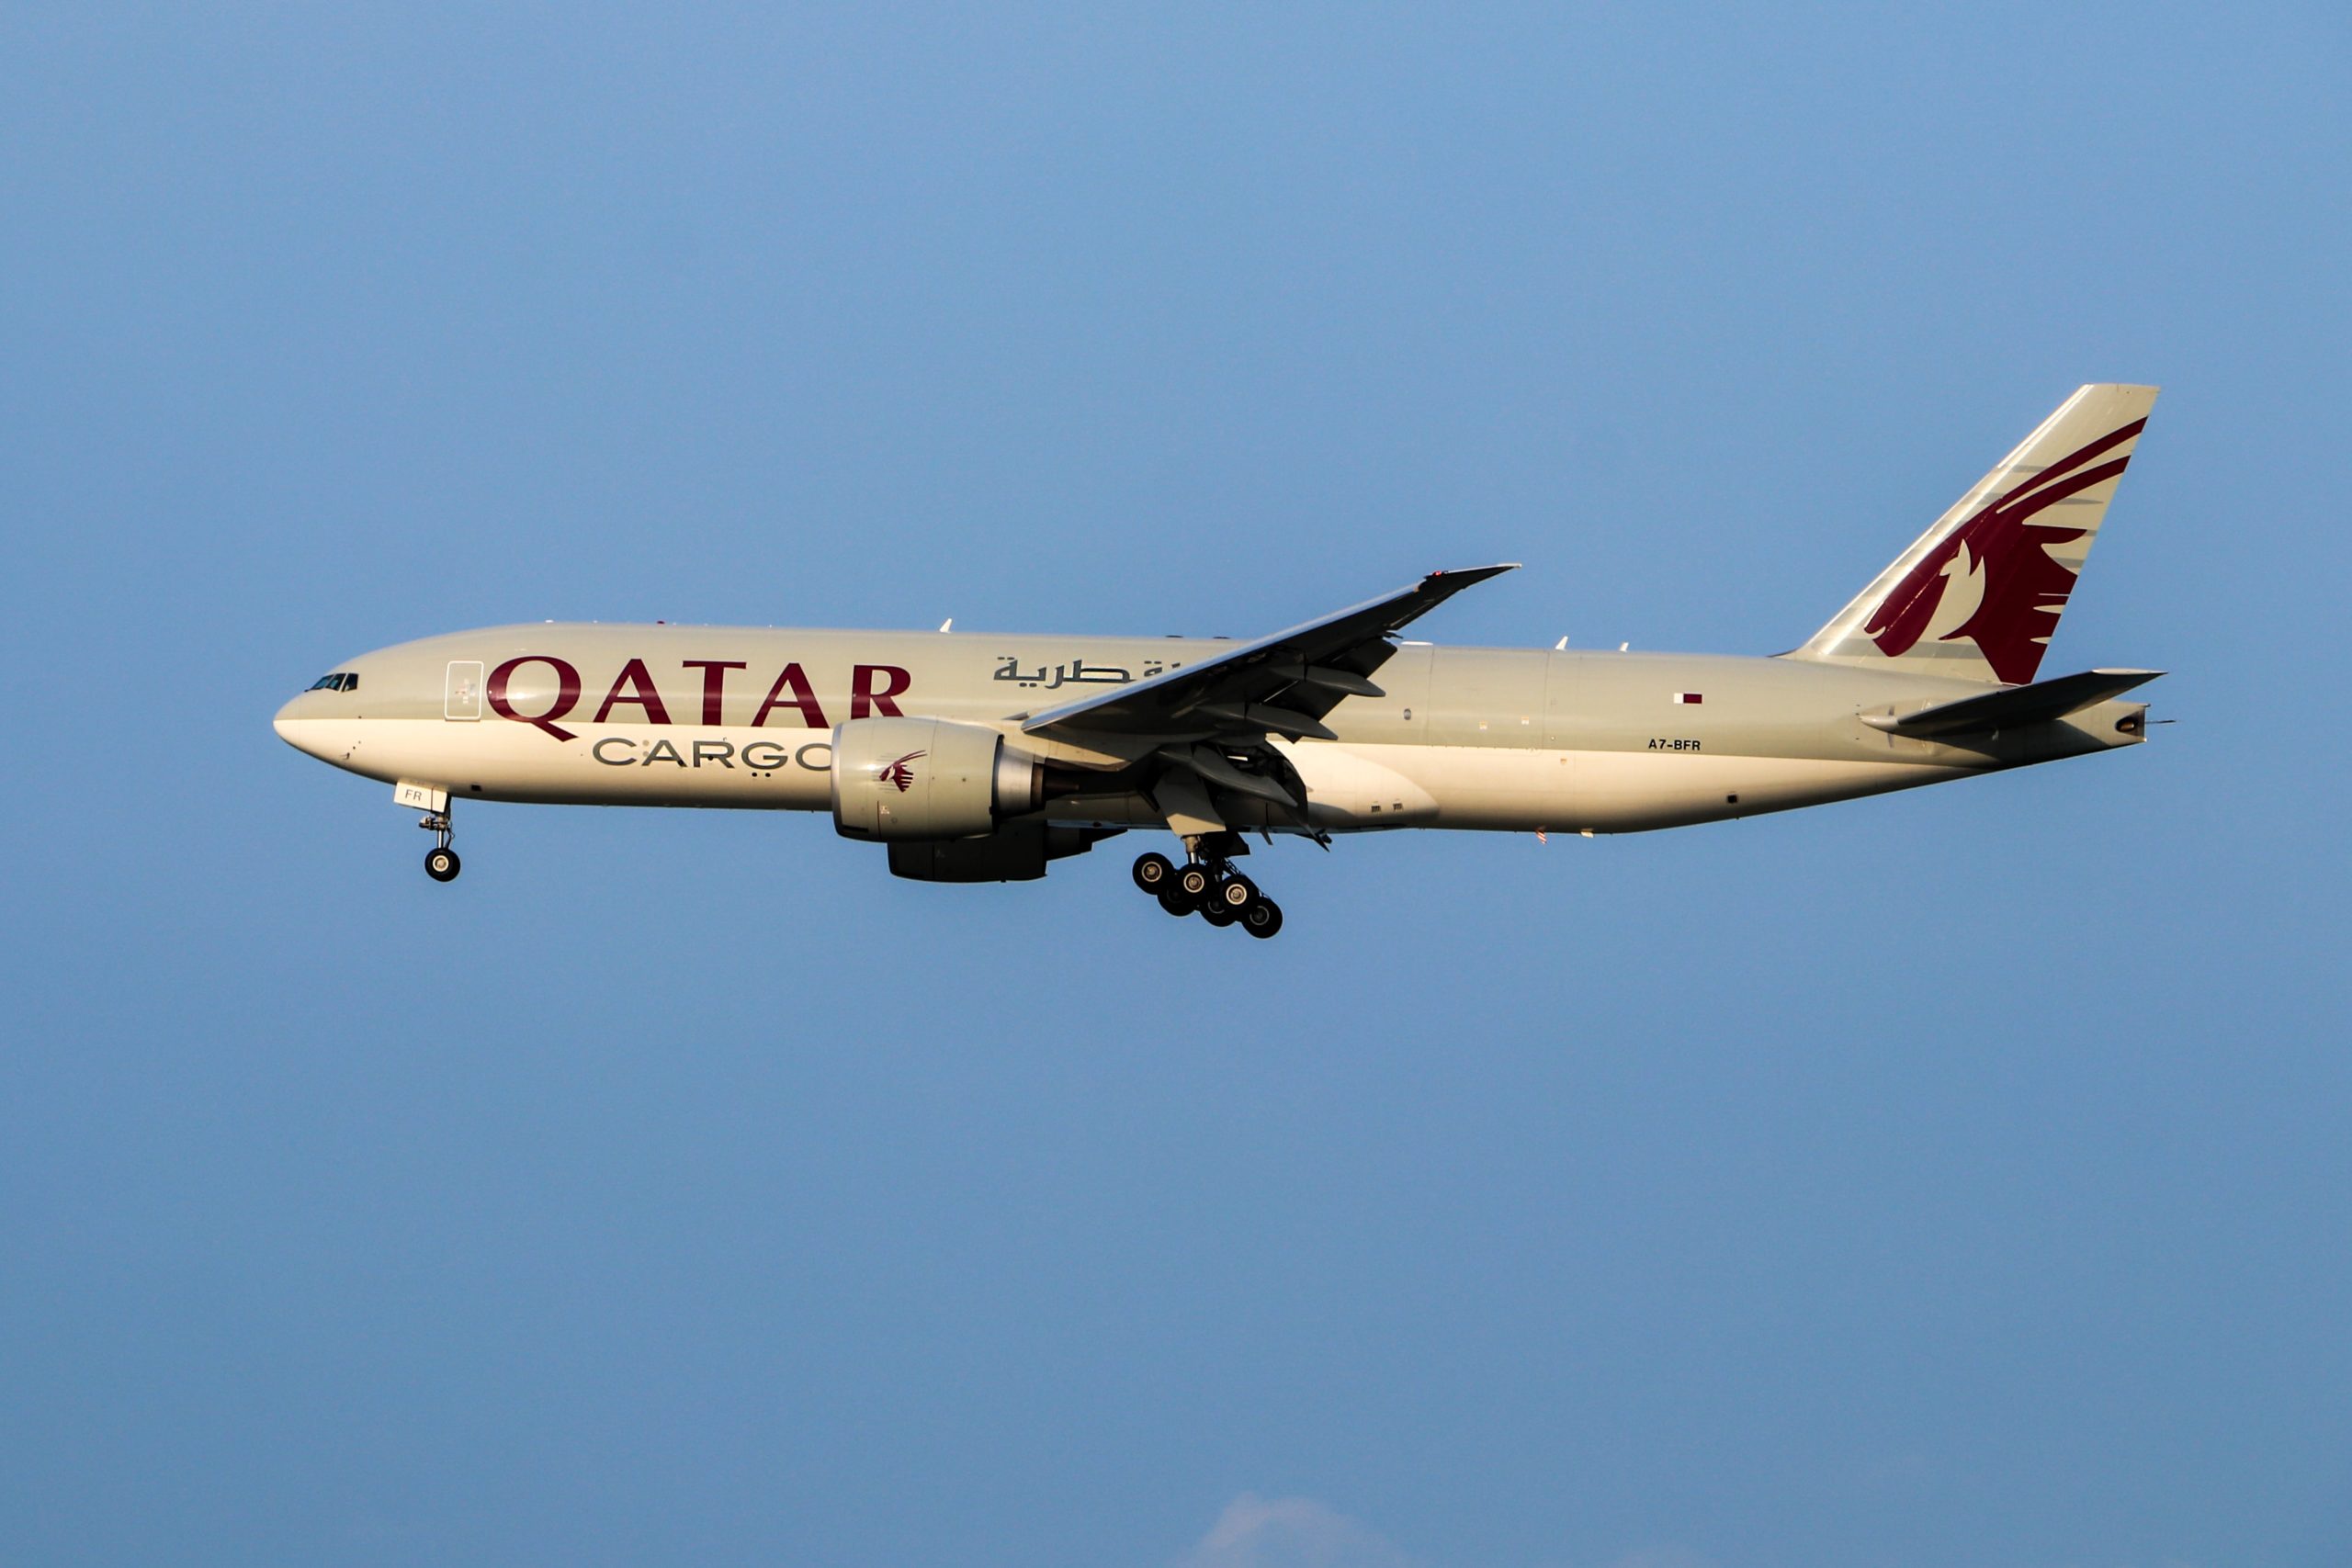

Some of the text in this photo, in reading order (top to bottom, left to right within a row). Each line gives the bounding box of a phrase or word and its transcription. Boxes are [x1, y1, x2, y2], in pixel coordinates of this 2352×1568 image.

[486, 656, 911, 742] QATAR
[593, 738, 831, 772] CARGO
[1648, 739, 1701, 750] A7-BFR
[404, 788, 423, 801] FR
